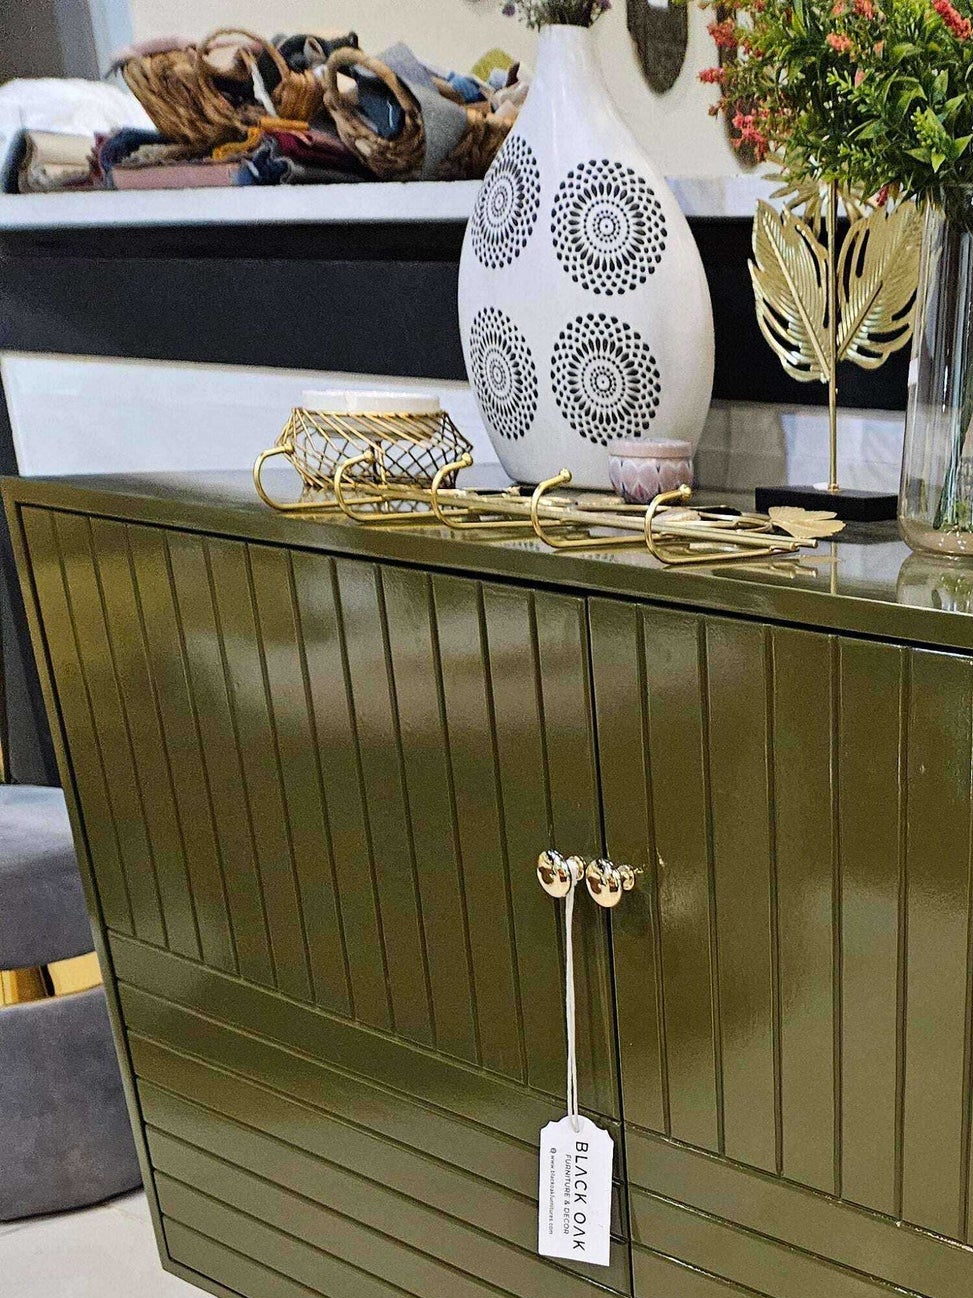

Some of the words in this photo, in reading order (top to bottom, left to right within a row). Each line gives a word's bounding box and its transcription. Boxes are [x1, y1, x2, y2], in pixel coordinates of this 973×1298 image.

[564, 1154, 572, 1198] FURNITURE
[574, 1141, 588, 1205] BLACK
[573, 1212, 586, 1251] OAK
